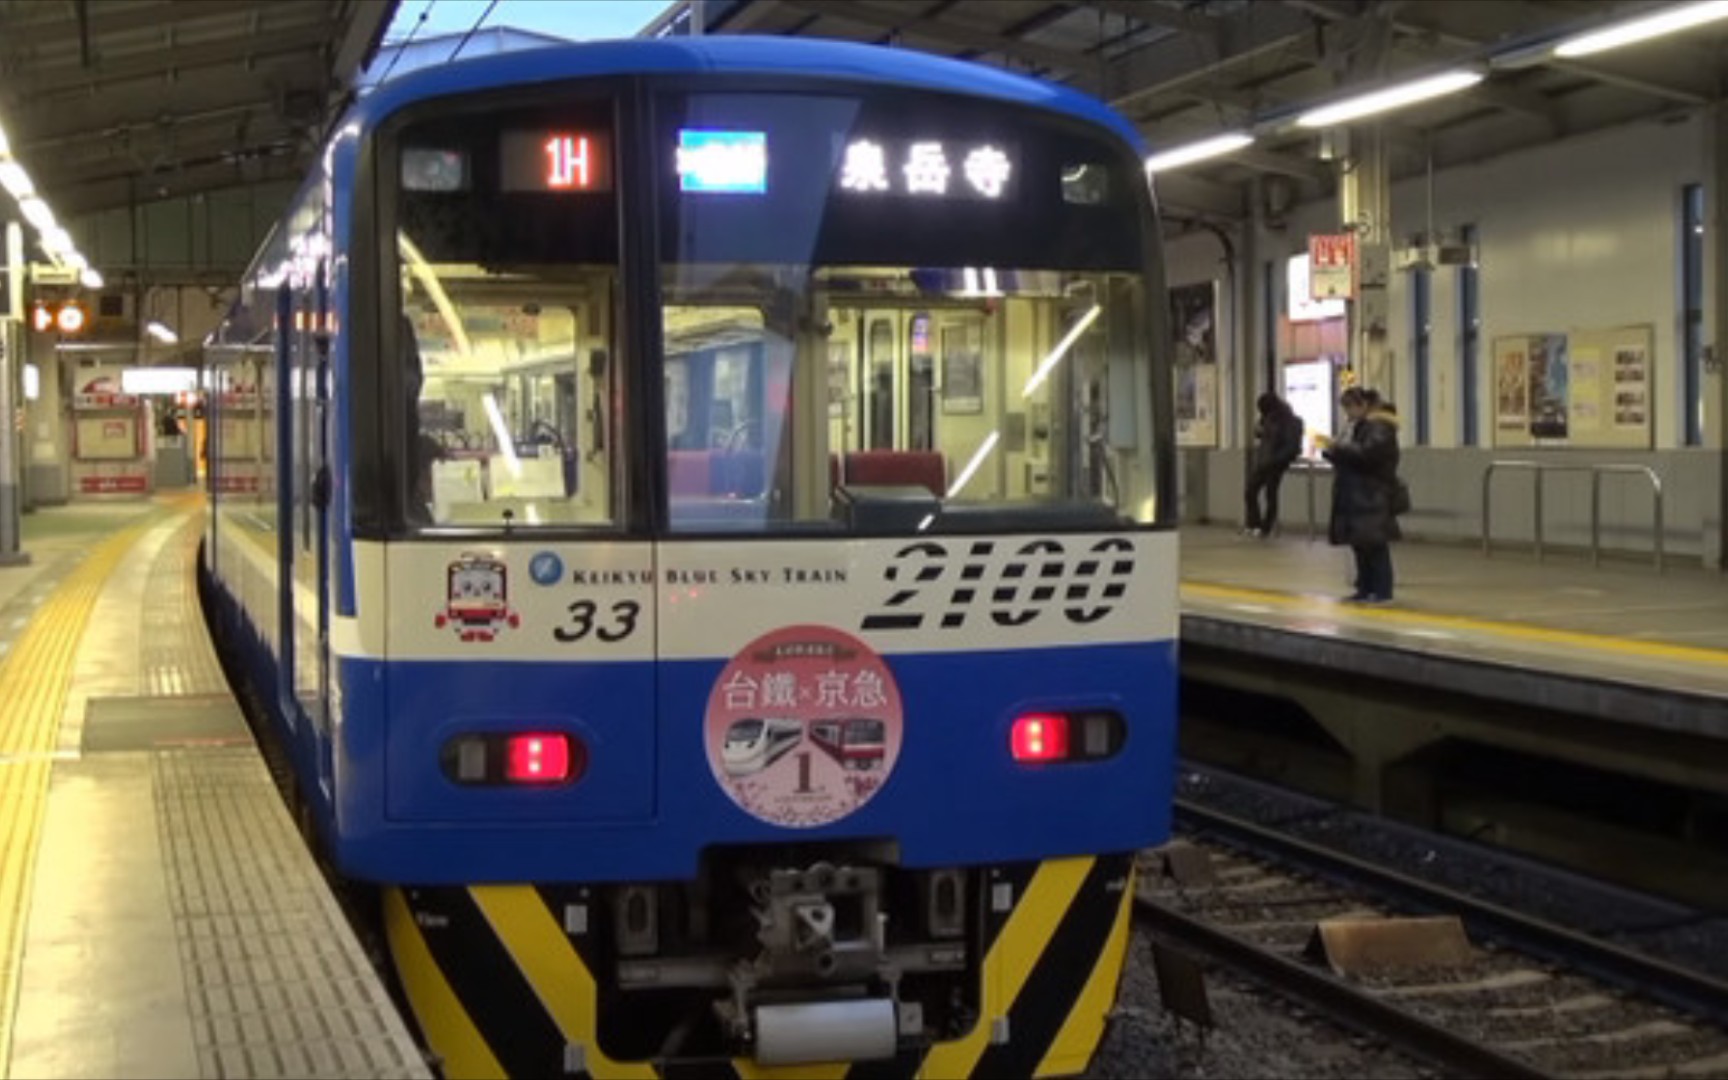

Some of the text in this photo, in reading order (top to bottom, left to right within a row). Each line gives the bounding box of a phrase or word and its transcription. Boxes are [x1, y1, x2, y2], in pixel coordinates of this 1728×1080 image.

[841, 139, 1011, 198] 泉岳寺
[573, 567, 847, 584] KEIKYU BLUE SKY TRAIN
[860, 538, 1135, 629] 2100
[553, 599, 640, 642] 33
